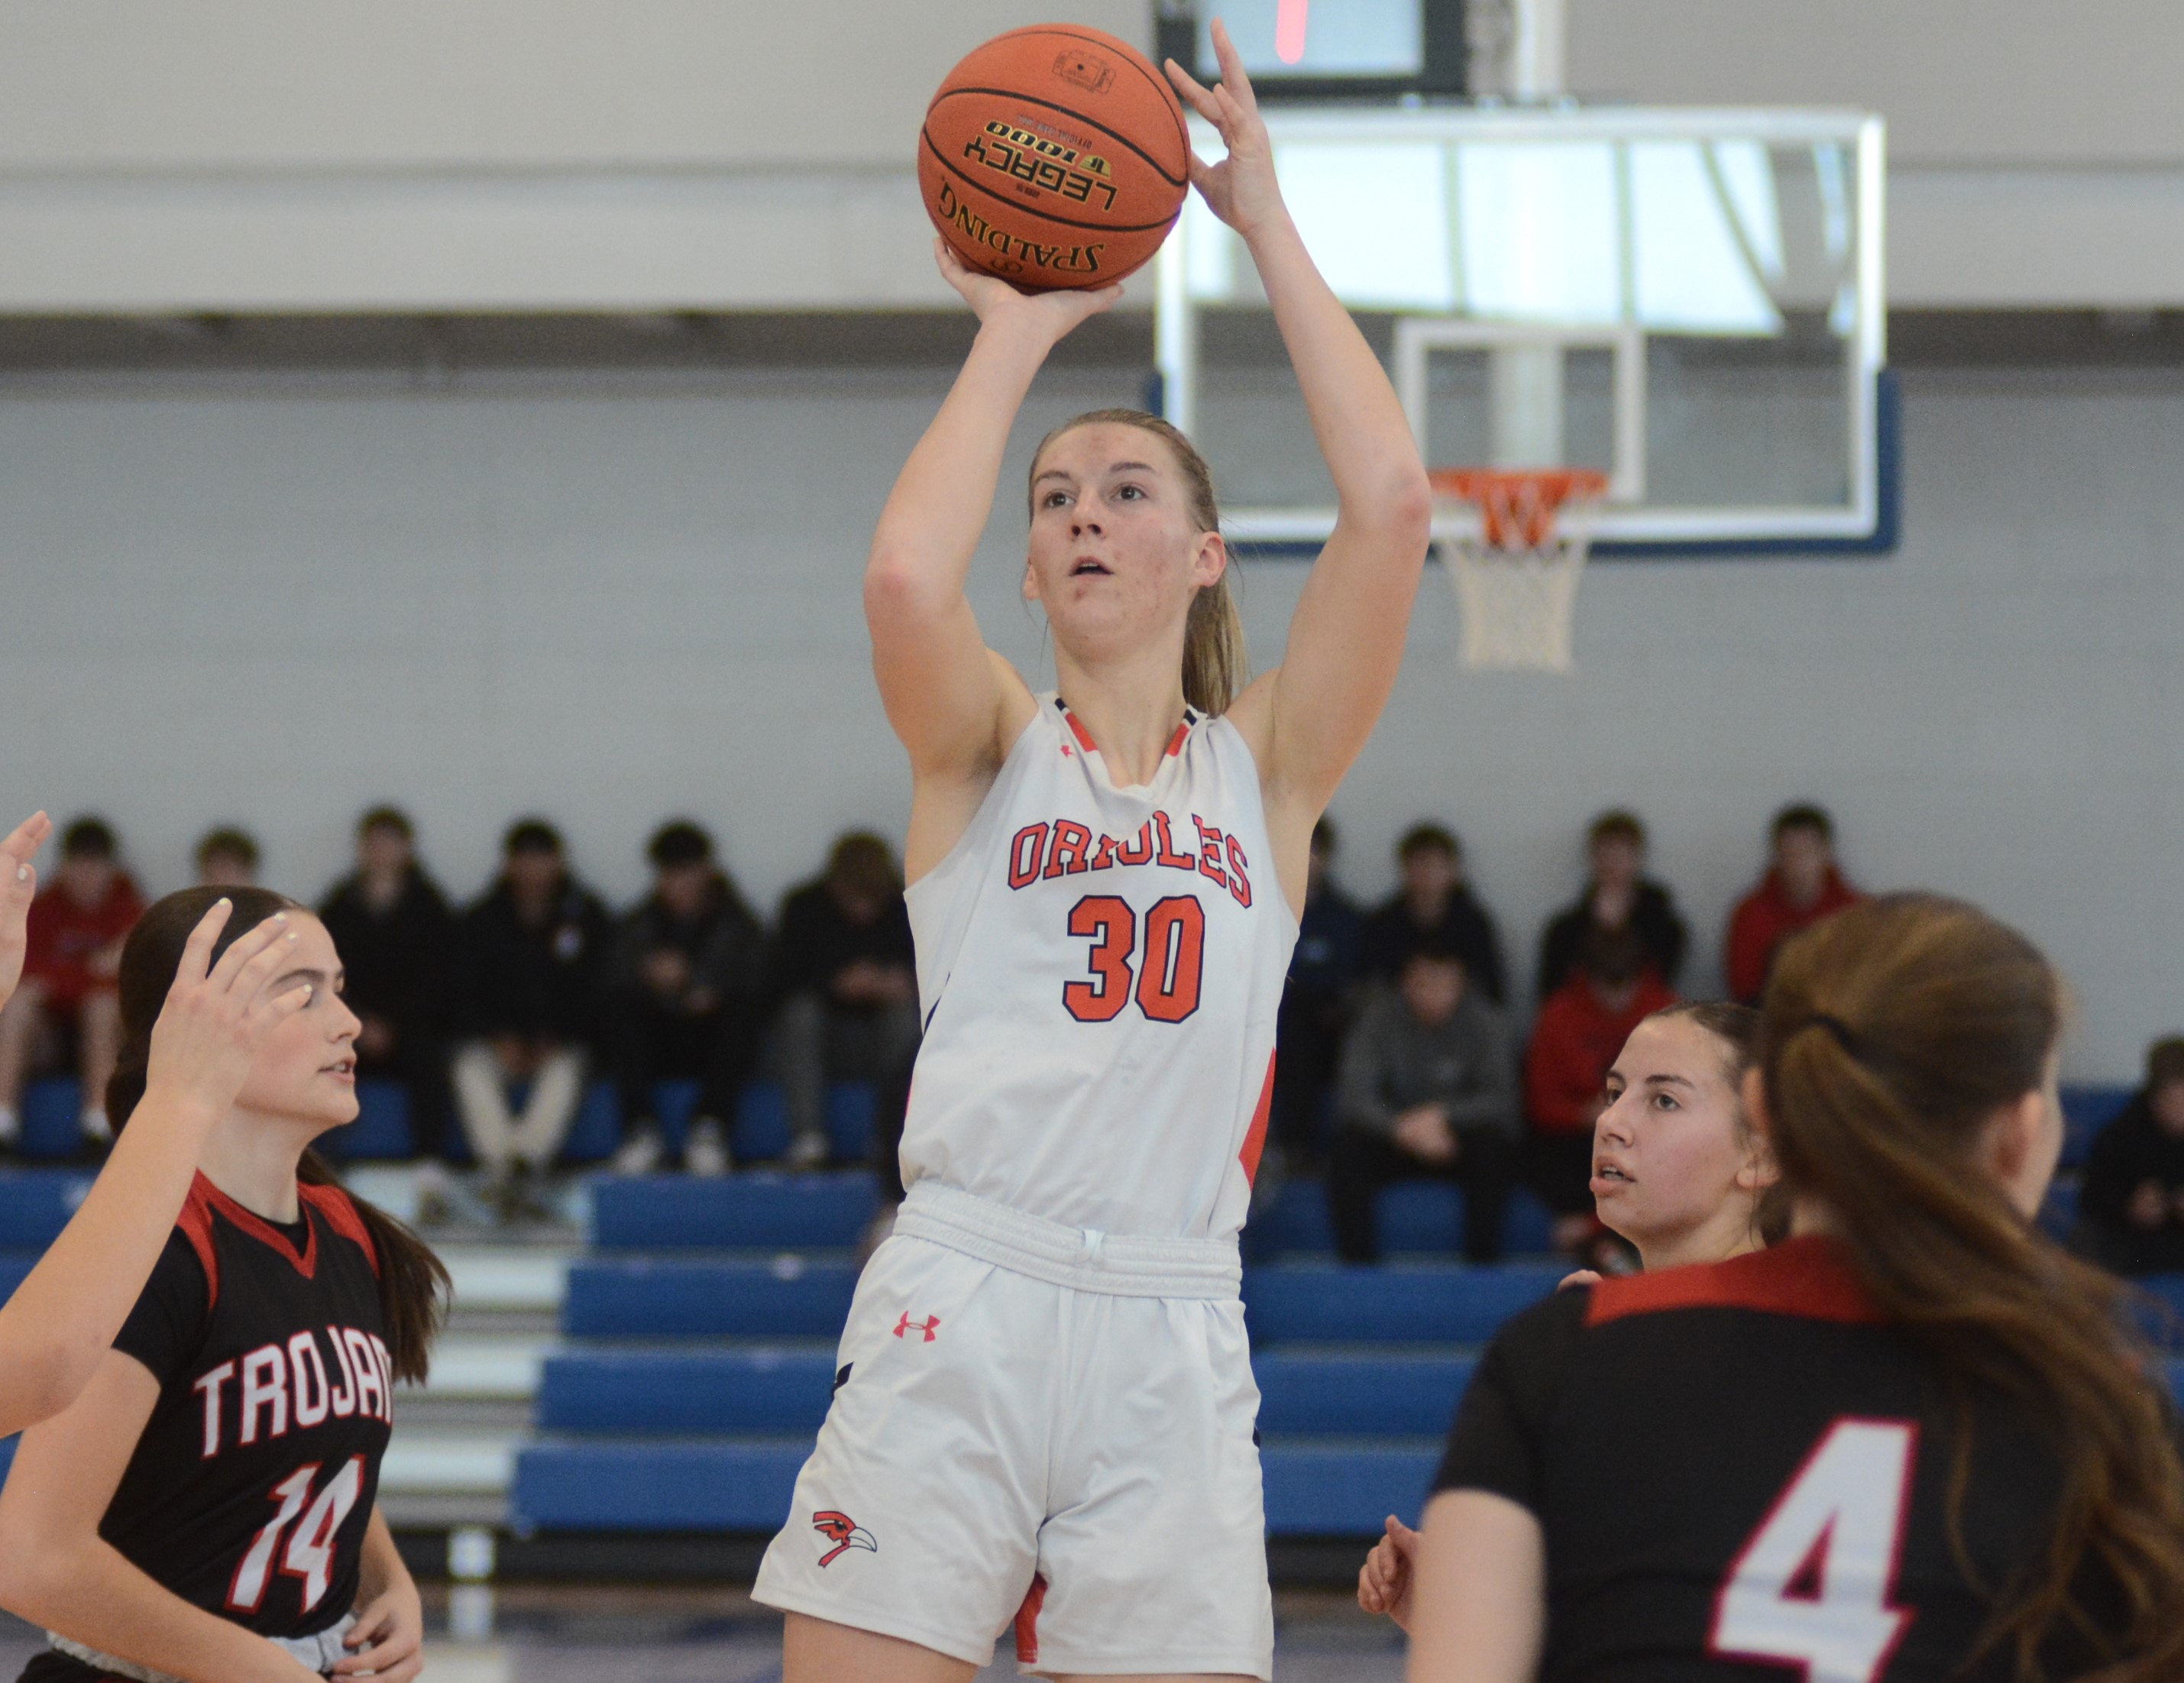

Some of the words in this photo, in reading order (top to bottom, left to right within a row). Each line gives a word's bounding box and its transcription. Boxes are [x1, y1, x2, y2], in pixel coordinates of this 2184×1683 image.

[963, 134, 1118, 212] LEGACY
[984, 119, 1079, 164] 1000
[938, 180, 1105, 273] SPALDING
[1008, 810, 1252, 909] ORIOLES
[1062, 895, 1205, 1024] 30
[224, 1453, 367, 1617] 14
[1704, 1413, 1923, 1683] 4
